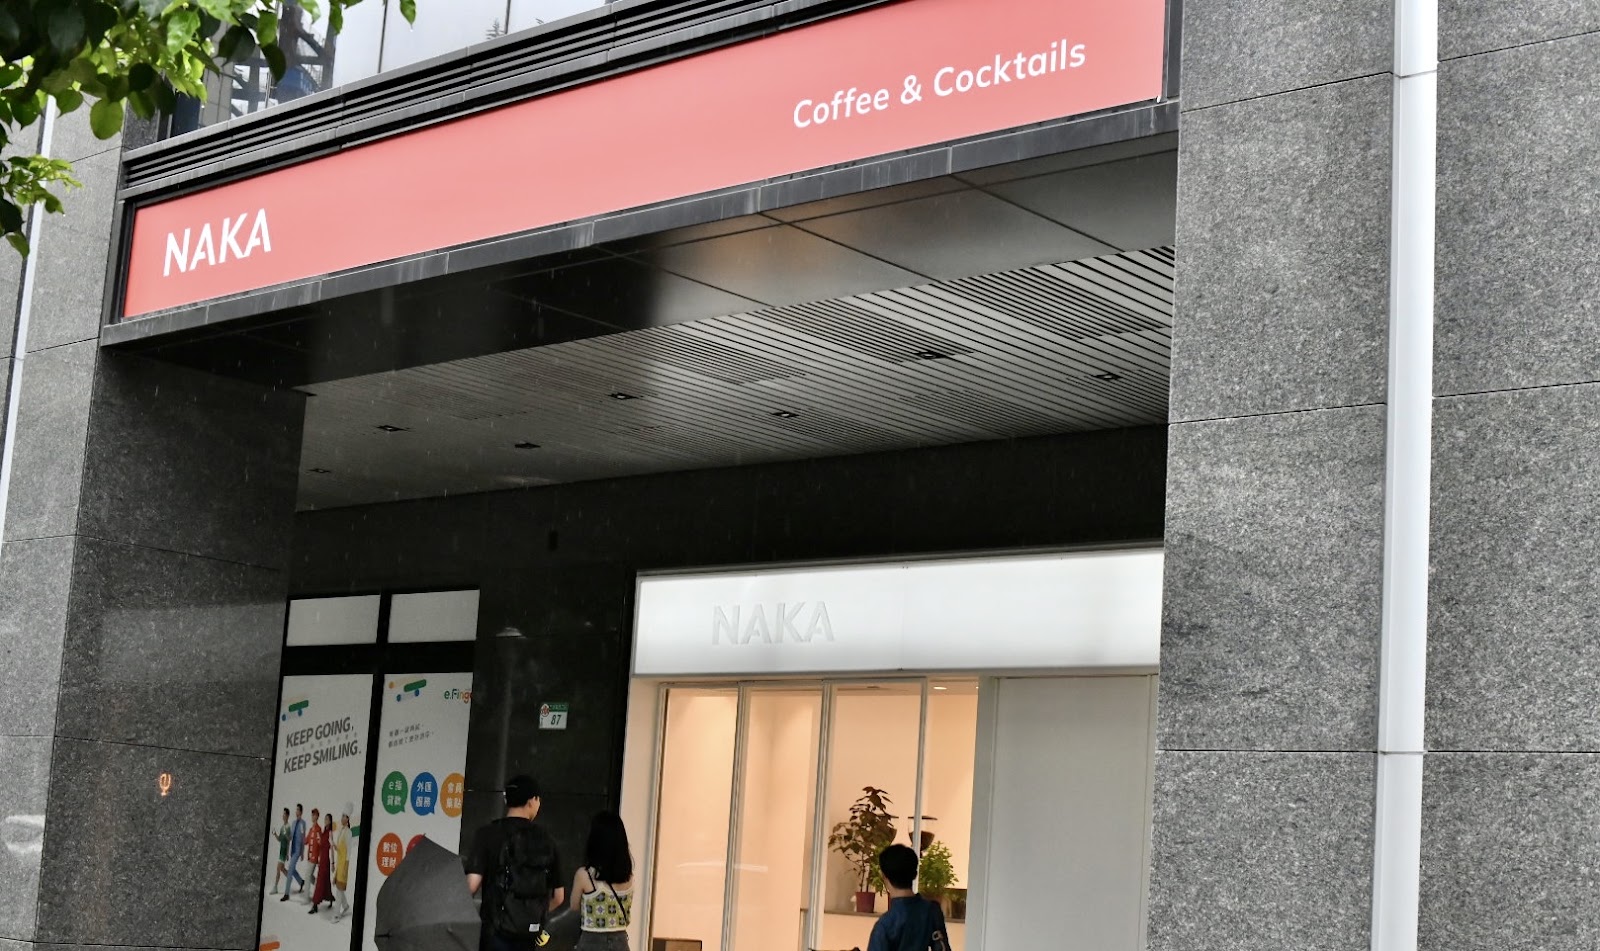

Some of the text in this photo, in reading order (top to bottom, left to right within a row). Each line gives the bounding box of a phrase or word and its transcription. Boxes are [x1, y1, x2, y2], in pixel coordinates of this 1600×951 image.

[793, 38, 1086, 128] Coffee & Cocktails
[163, 208, 272, 277] NAKA
[712, 600, 835, 645] NAKA
[551, 714, 562, 726] 87
[286, 727, 314, 748] KEEP
[315, 716, 354, 740] GOING,
[283, 753, 312, 774] KEEP
[312, 740, 362, 766] SMILING.
[416, 781, 433, 793] 外匯
[386, 795, 402, 807] 貸款
[415, 796, 431, 808] 服務
[383, 842, 398, 853] 數位
[381, 856, 397, 869] 理財
